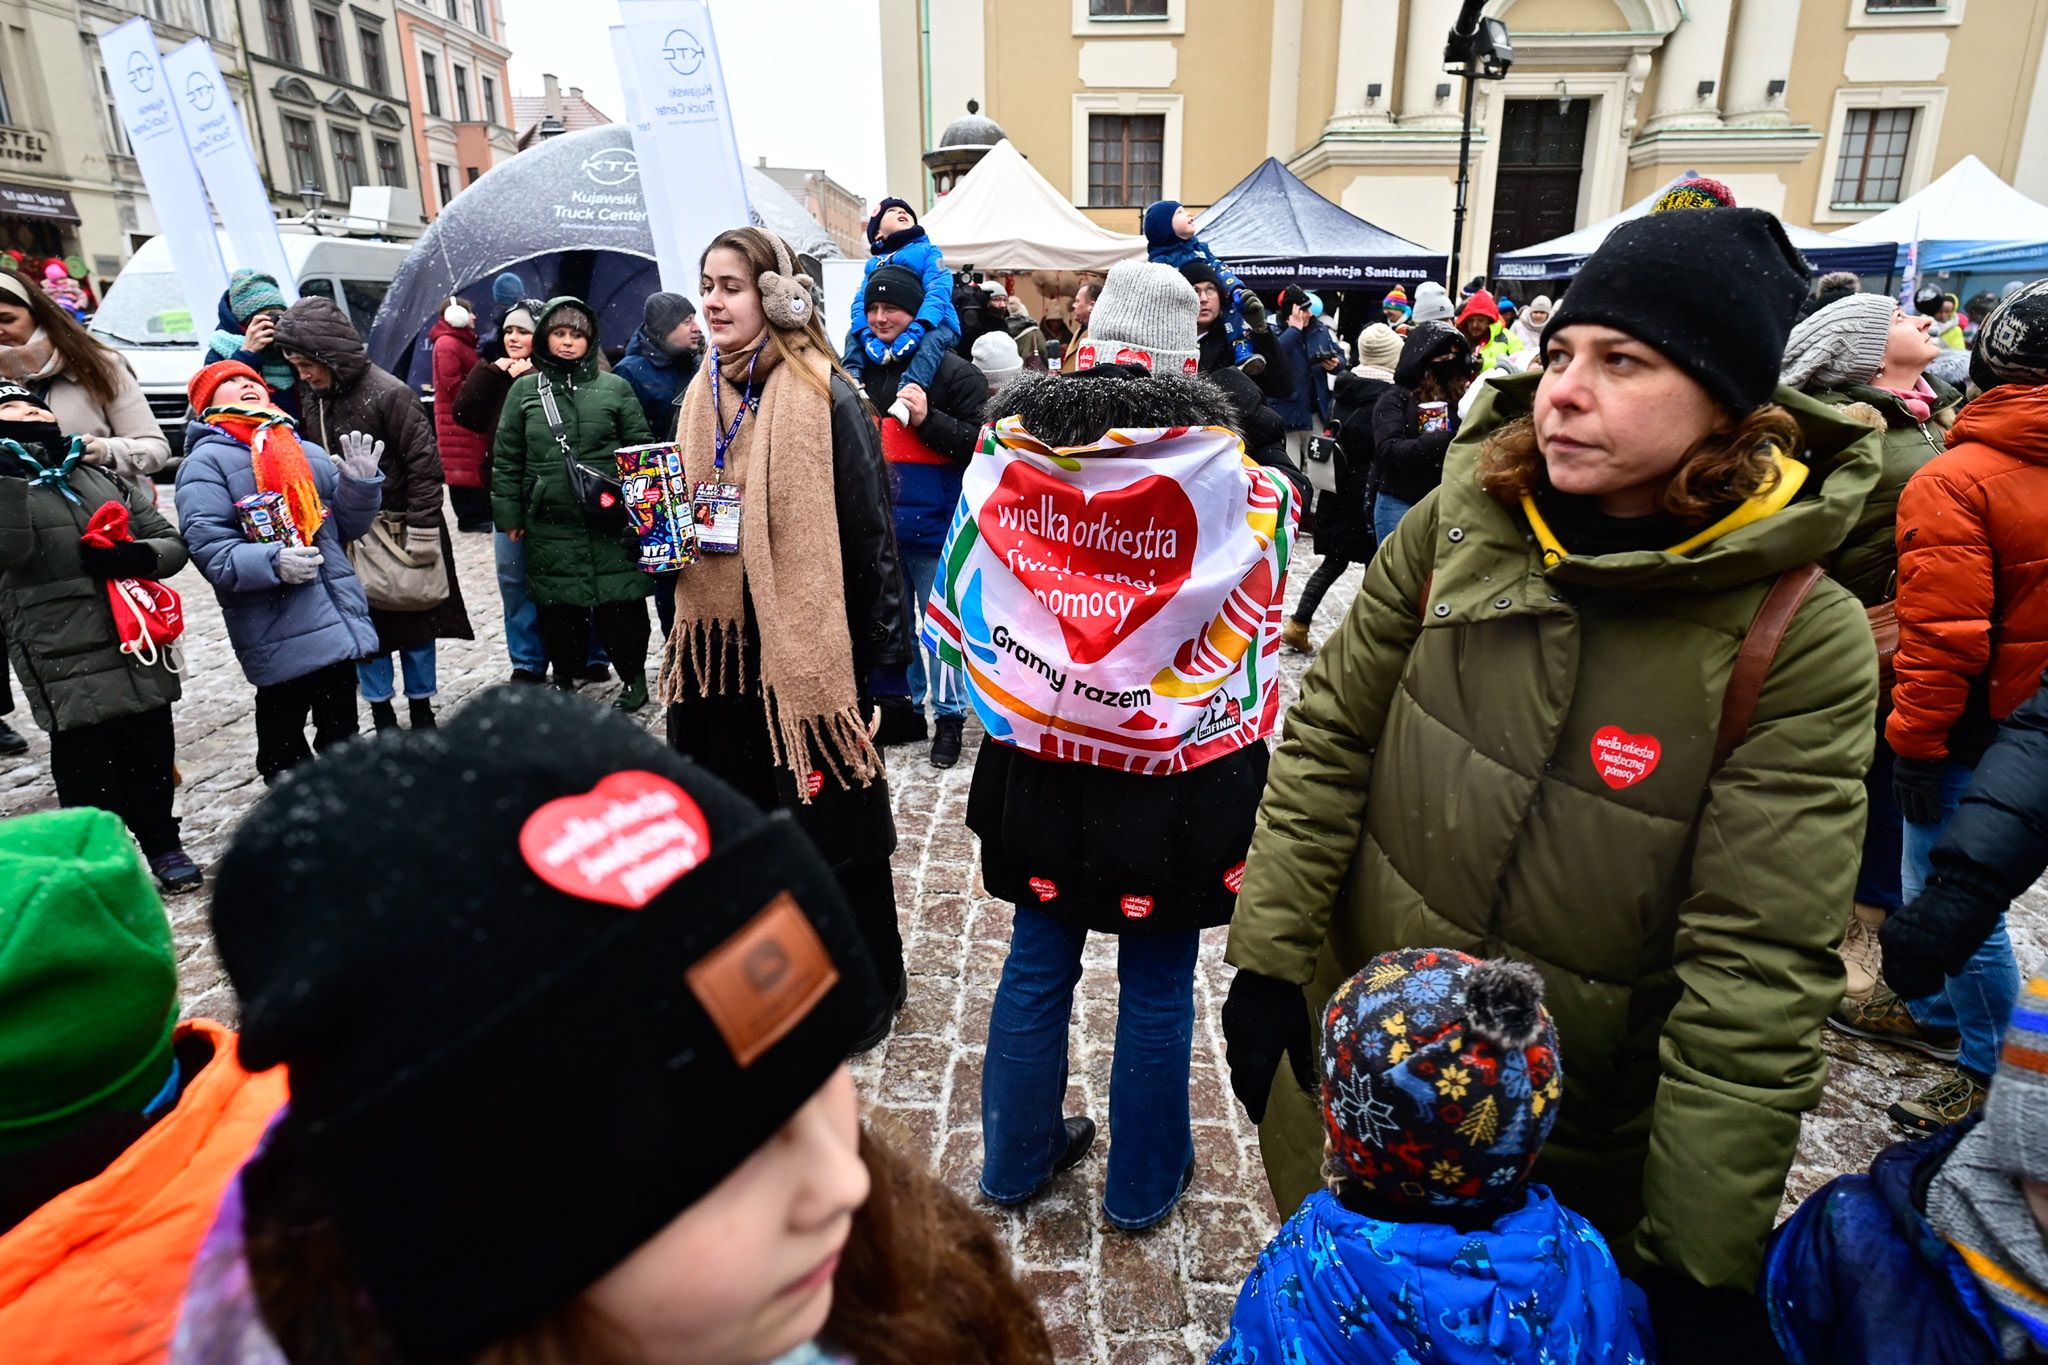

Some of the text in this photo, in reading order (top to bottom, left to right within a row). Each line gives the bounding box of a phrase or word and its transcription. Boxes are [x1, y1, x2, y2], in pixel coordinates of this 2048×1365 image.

[571, 190, 637, 205] Kujawski
[553, 204, 649, 222] Truck Center
[1230, 263, 1427, 279] aństwowa Inspekcja Sanitarna
[624, 476, 649, 507] 34
[997, 494, 1177, 560] wielka orkiestra
[992, 625, 1151, 708] Gramy razem
[1211, 717, 1237, 733] FINAL
[1597, 736, 1655, 760] wielka orkiestra
[1599, 748, 1646, 776] świątecznej
[1604, 765, 1636, 783] pomocy
